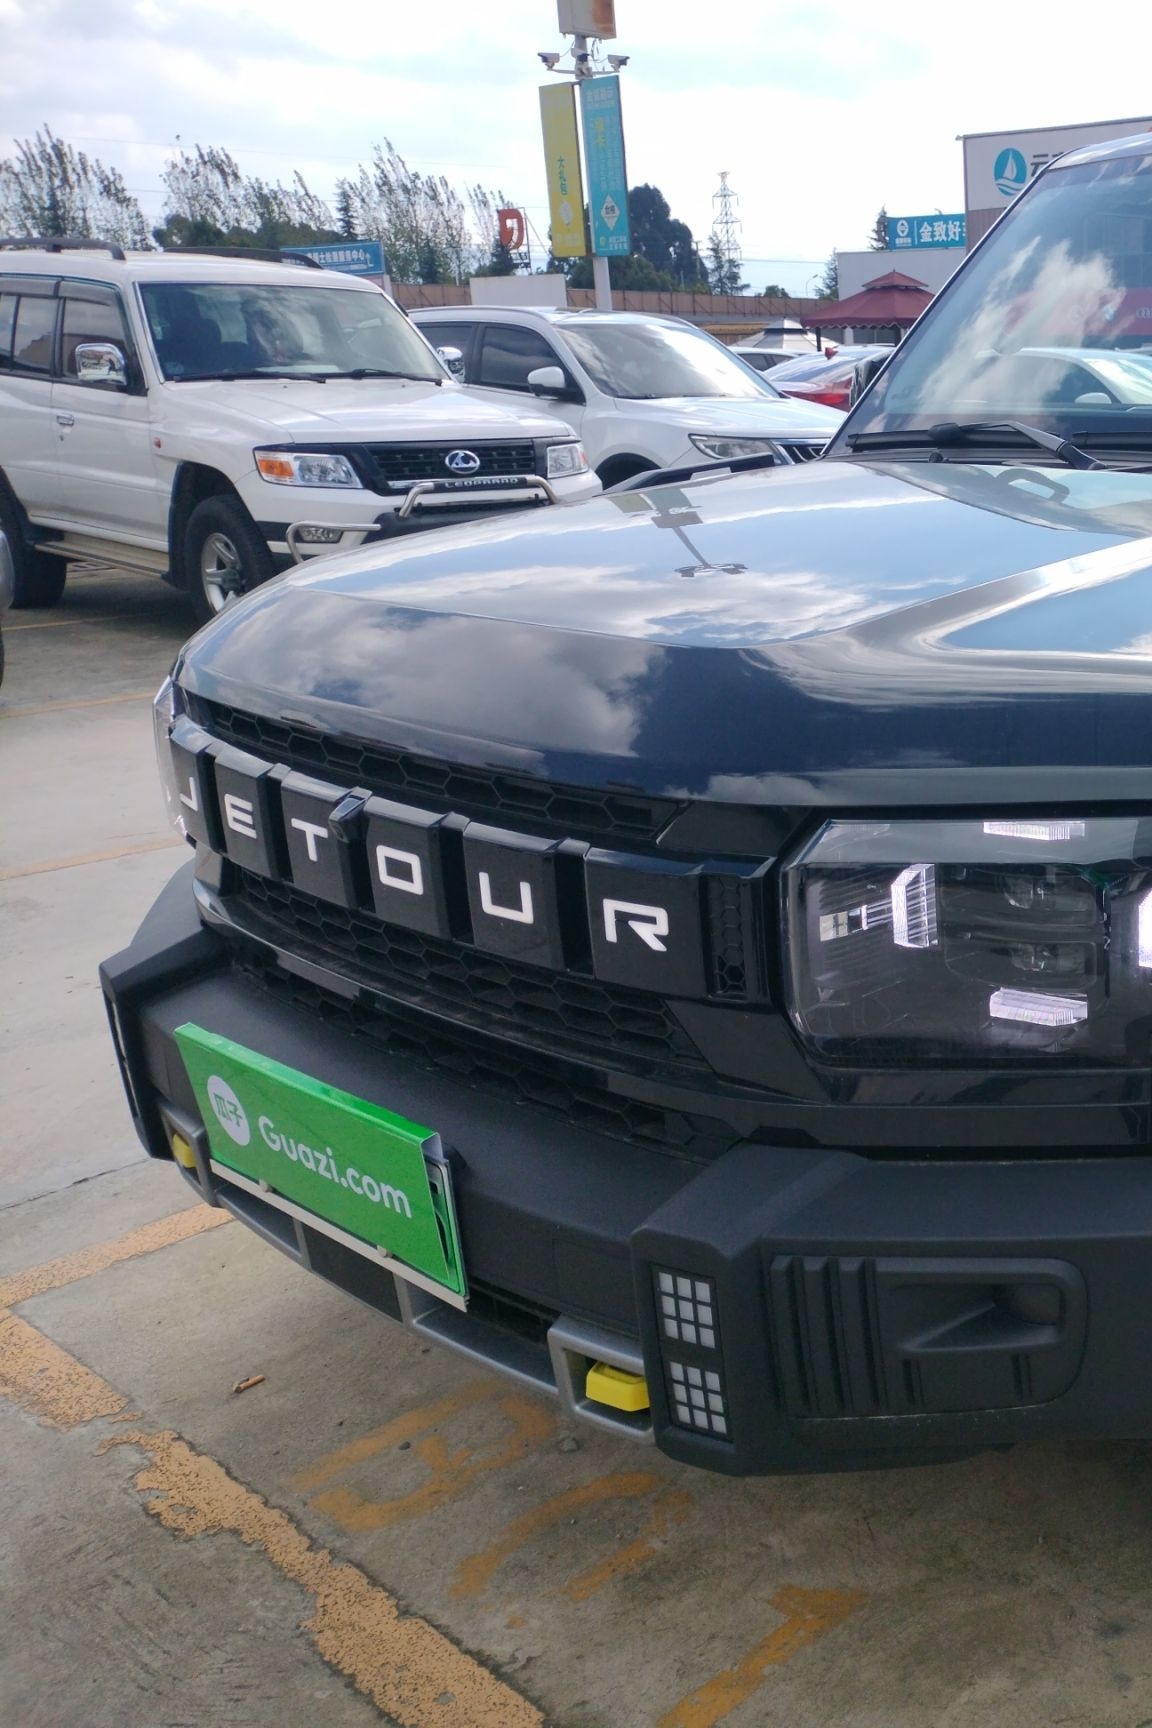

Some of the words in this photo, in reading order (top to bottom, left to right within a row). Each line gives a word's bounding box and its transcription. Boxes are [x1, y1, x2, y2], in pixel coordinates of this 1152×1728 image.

[178, 776, 669, 952] JETOUR
[213, 1092, 243, 1127] 瓜子
[258, 1115, 412, 1218] Guazi.com
